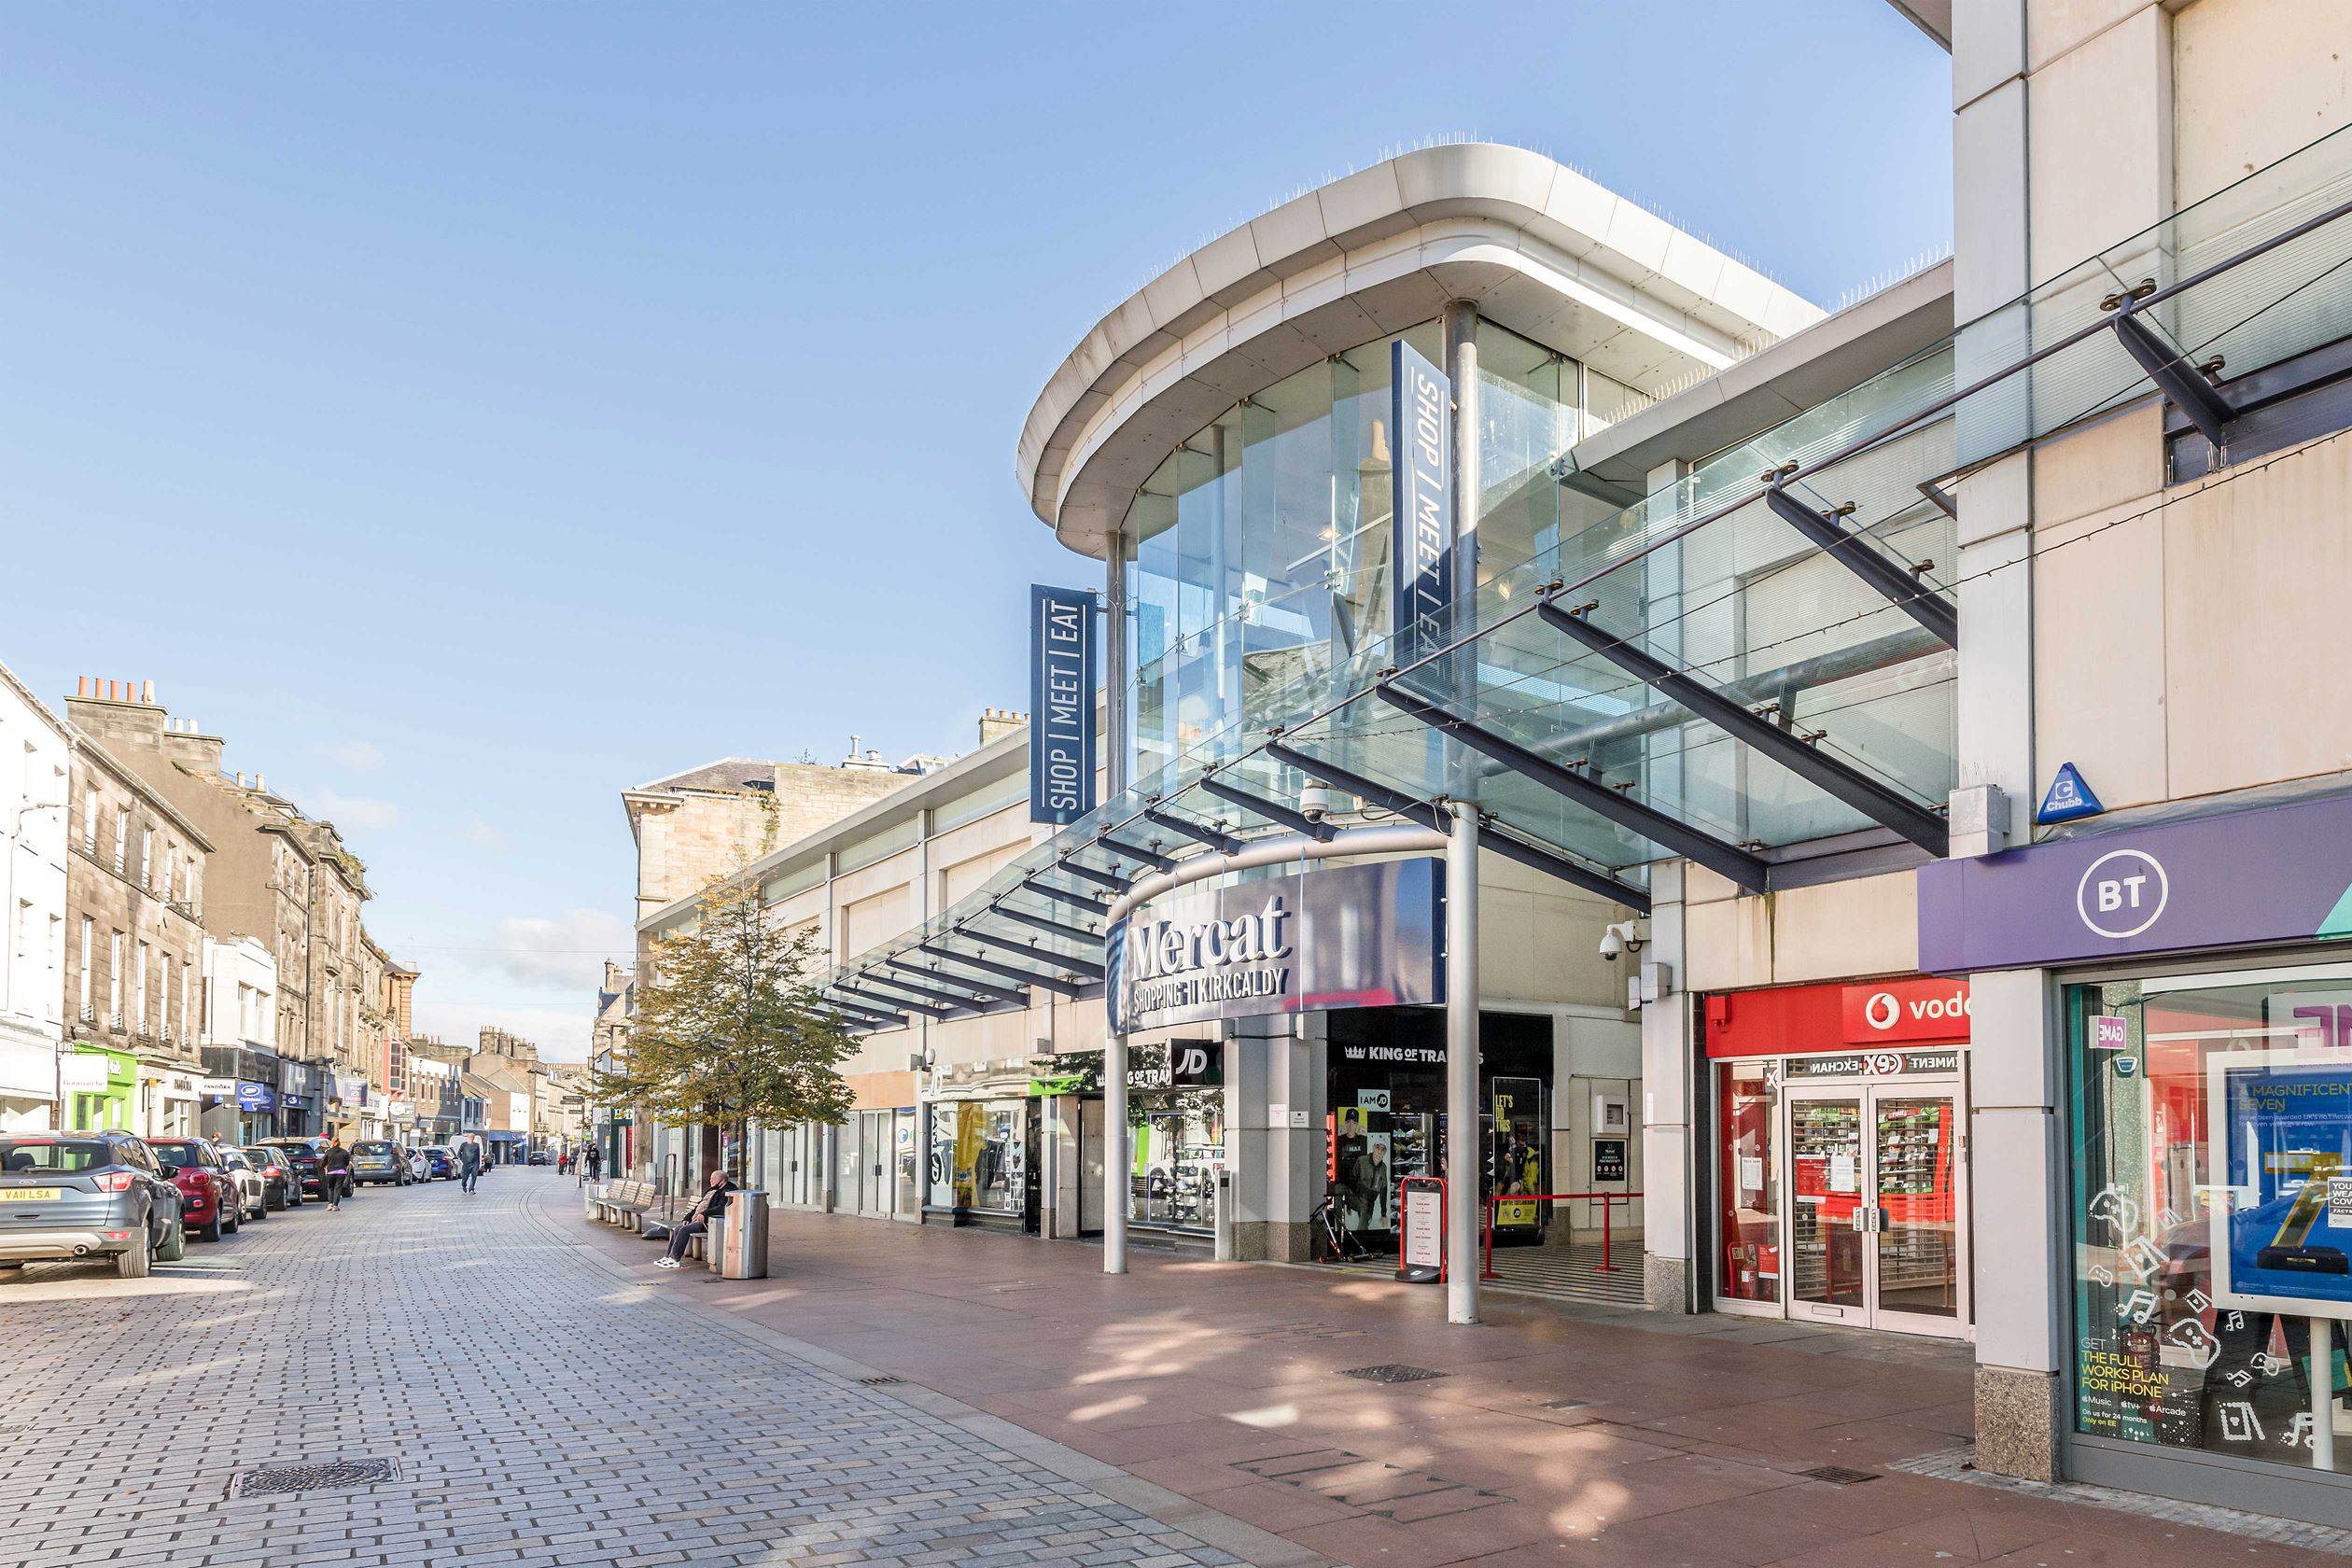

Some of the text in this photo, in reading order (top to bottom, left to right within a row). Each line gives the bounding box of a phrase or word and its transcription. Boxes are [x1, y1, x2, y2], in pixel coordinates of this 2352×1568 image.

[1417, 373, 1440, 468] SHOP
[1418, 493, 1441, 587] MEET
[1050, 599, 1079, 643] EAT
[1050, 665, 1078, 725] MEET
[1050, 749, 1078, 811] SHOP
[2046, 796, 2082, 812] Chubb
[2098, 875, 2147, 913] BT
[1130, 895, 1292, 981] Mercat
[1134, 981, 1183, 1014] SHOPPING
[1200, 967, 1285, 1002] KIRKCALDY
[1175, 1048, 1208, 1075] JD
[1368, 1046, 1403, 1061] KING
[1404, 1048, 1418, 1061] OF
[1134, 1070, 1145, 1084] OF
[1364, 1096, 1376, 1104] AM
[1495, 1094, 1514, 1109] LET'S
[2239, 1098, 2286, 1112] SEVEN
[1495, 1107, 1505, 1121] DO
[1495, 1119, 1511, 1133] THIS
[29, 1190, 50, 1199] LSA
[2080, 1337, 2107, 1351] GET
[2081, 1350, 2143, 1368] THE FULL
[2080, 1363, 2169, 1386] WORKS PLAN
[2081, 1377, 2163, 1398] FOR iPHONE
[2088, 1395, 2112, 1407] Music
[2155, 1405, 2187, 1417] Arcade
[2081, 1416, 2097, 1425] Only
[2122, 1414, 2148, 1424] months
